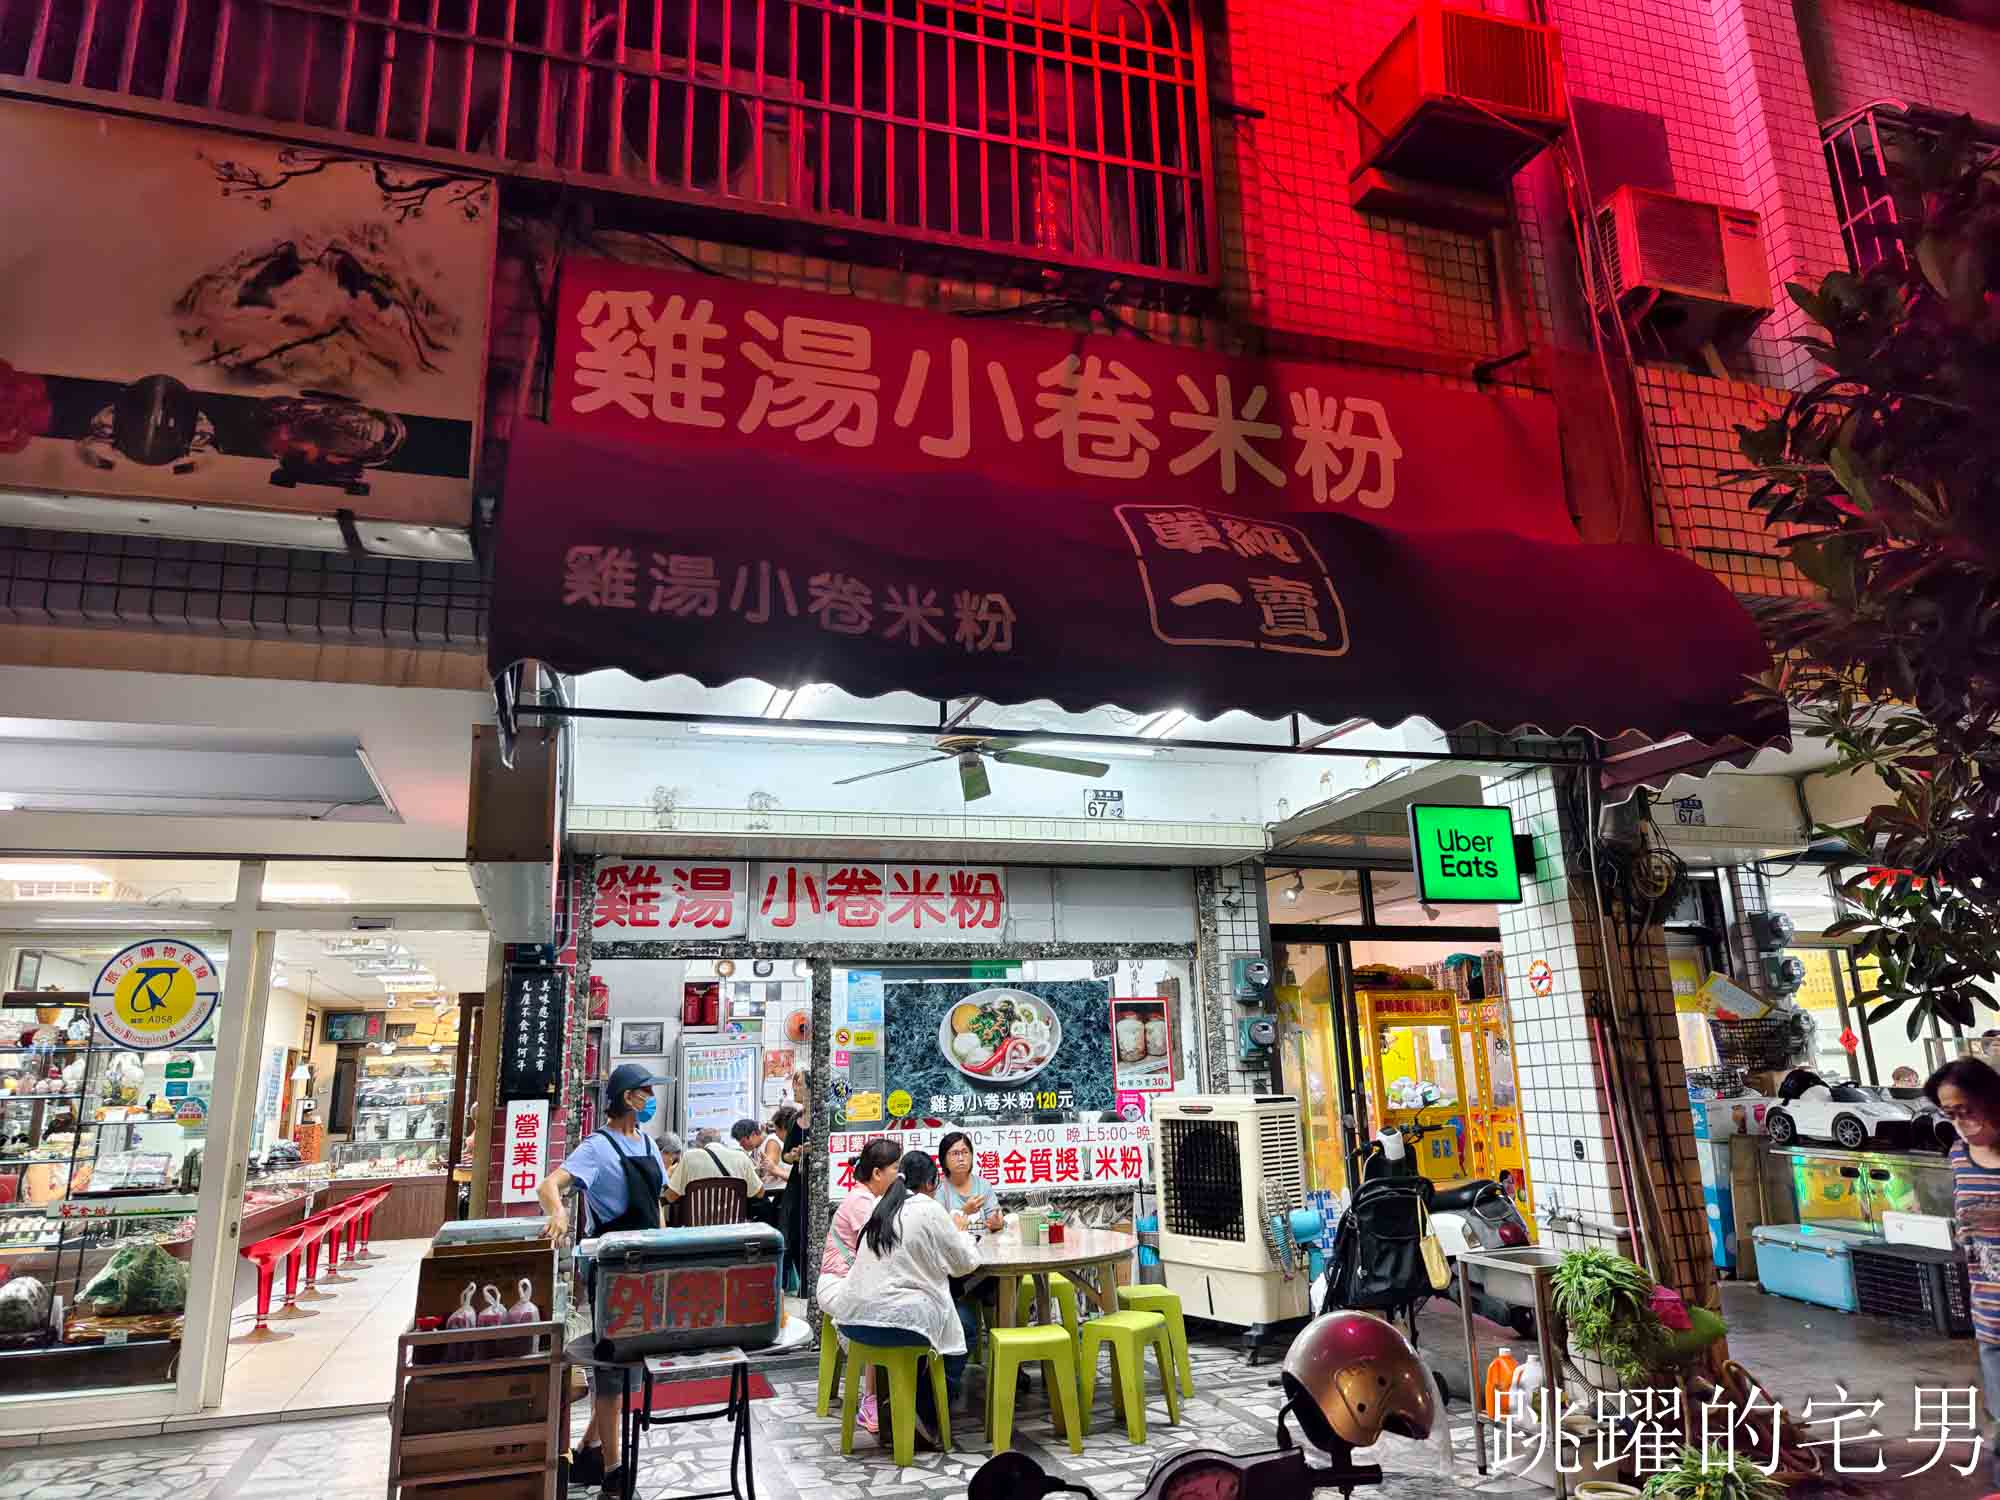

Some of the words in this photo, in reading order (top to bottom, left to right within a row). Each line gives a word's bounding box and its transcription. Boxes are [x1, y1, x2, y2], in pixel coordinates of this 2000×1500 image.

[572, 289, 1404, 510] 雞湯小卷米粉
[563, 544, 1018, 653] 雞湯小卷米粉
[1436, 828, 1494, 853] Uber
[1440, 854, 1499, 878] Eats
[511, 1113, 539, 1196] 營業中
[1095, 1145, 1143, 1180] 米粉
